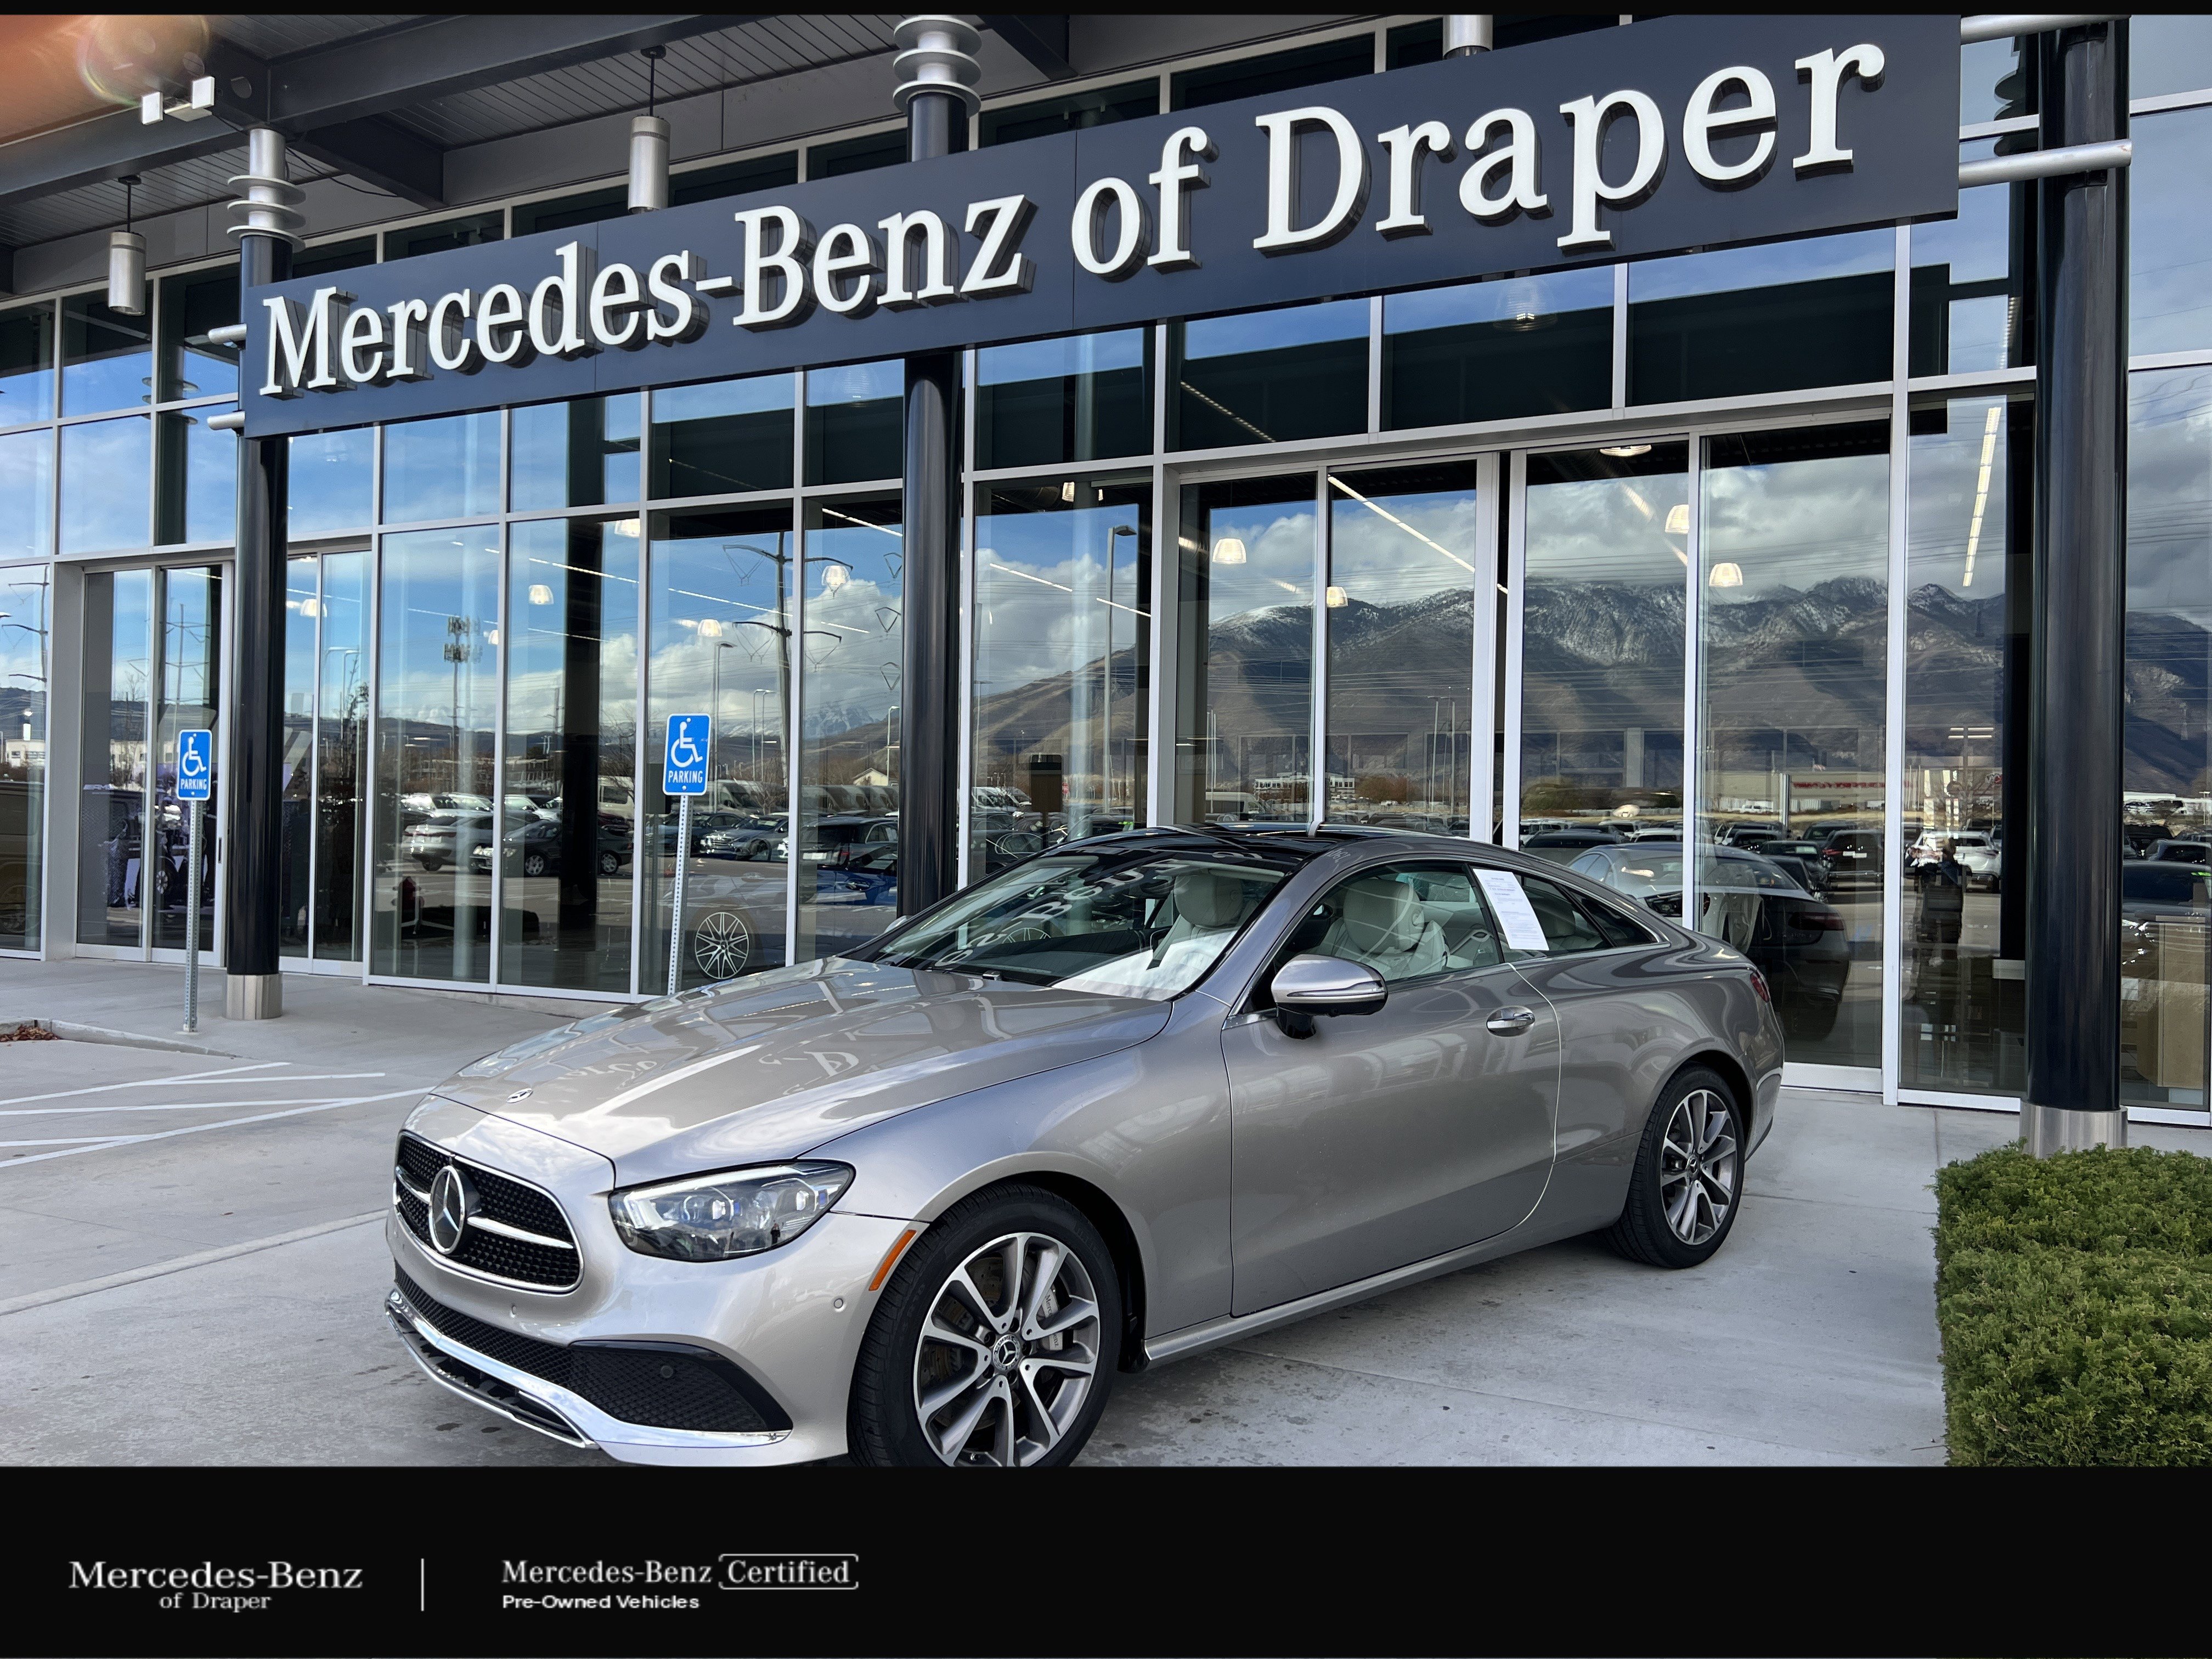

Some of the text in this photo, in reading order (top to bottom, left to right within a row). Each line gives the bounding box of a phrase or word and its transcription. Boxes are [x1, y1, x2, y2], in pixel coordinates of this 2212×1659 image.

[260, 44, 1885, 396] Mercedes-Benz of Draper
[668, 770, 703, 783] PARKING
[180, 778, 207, 790] PARKING
